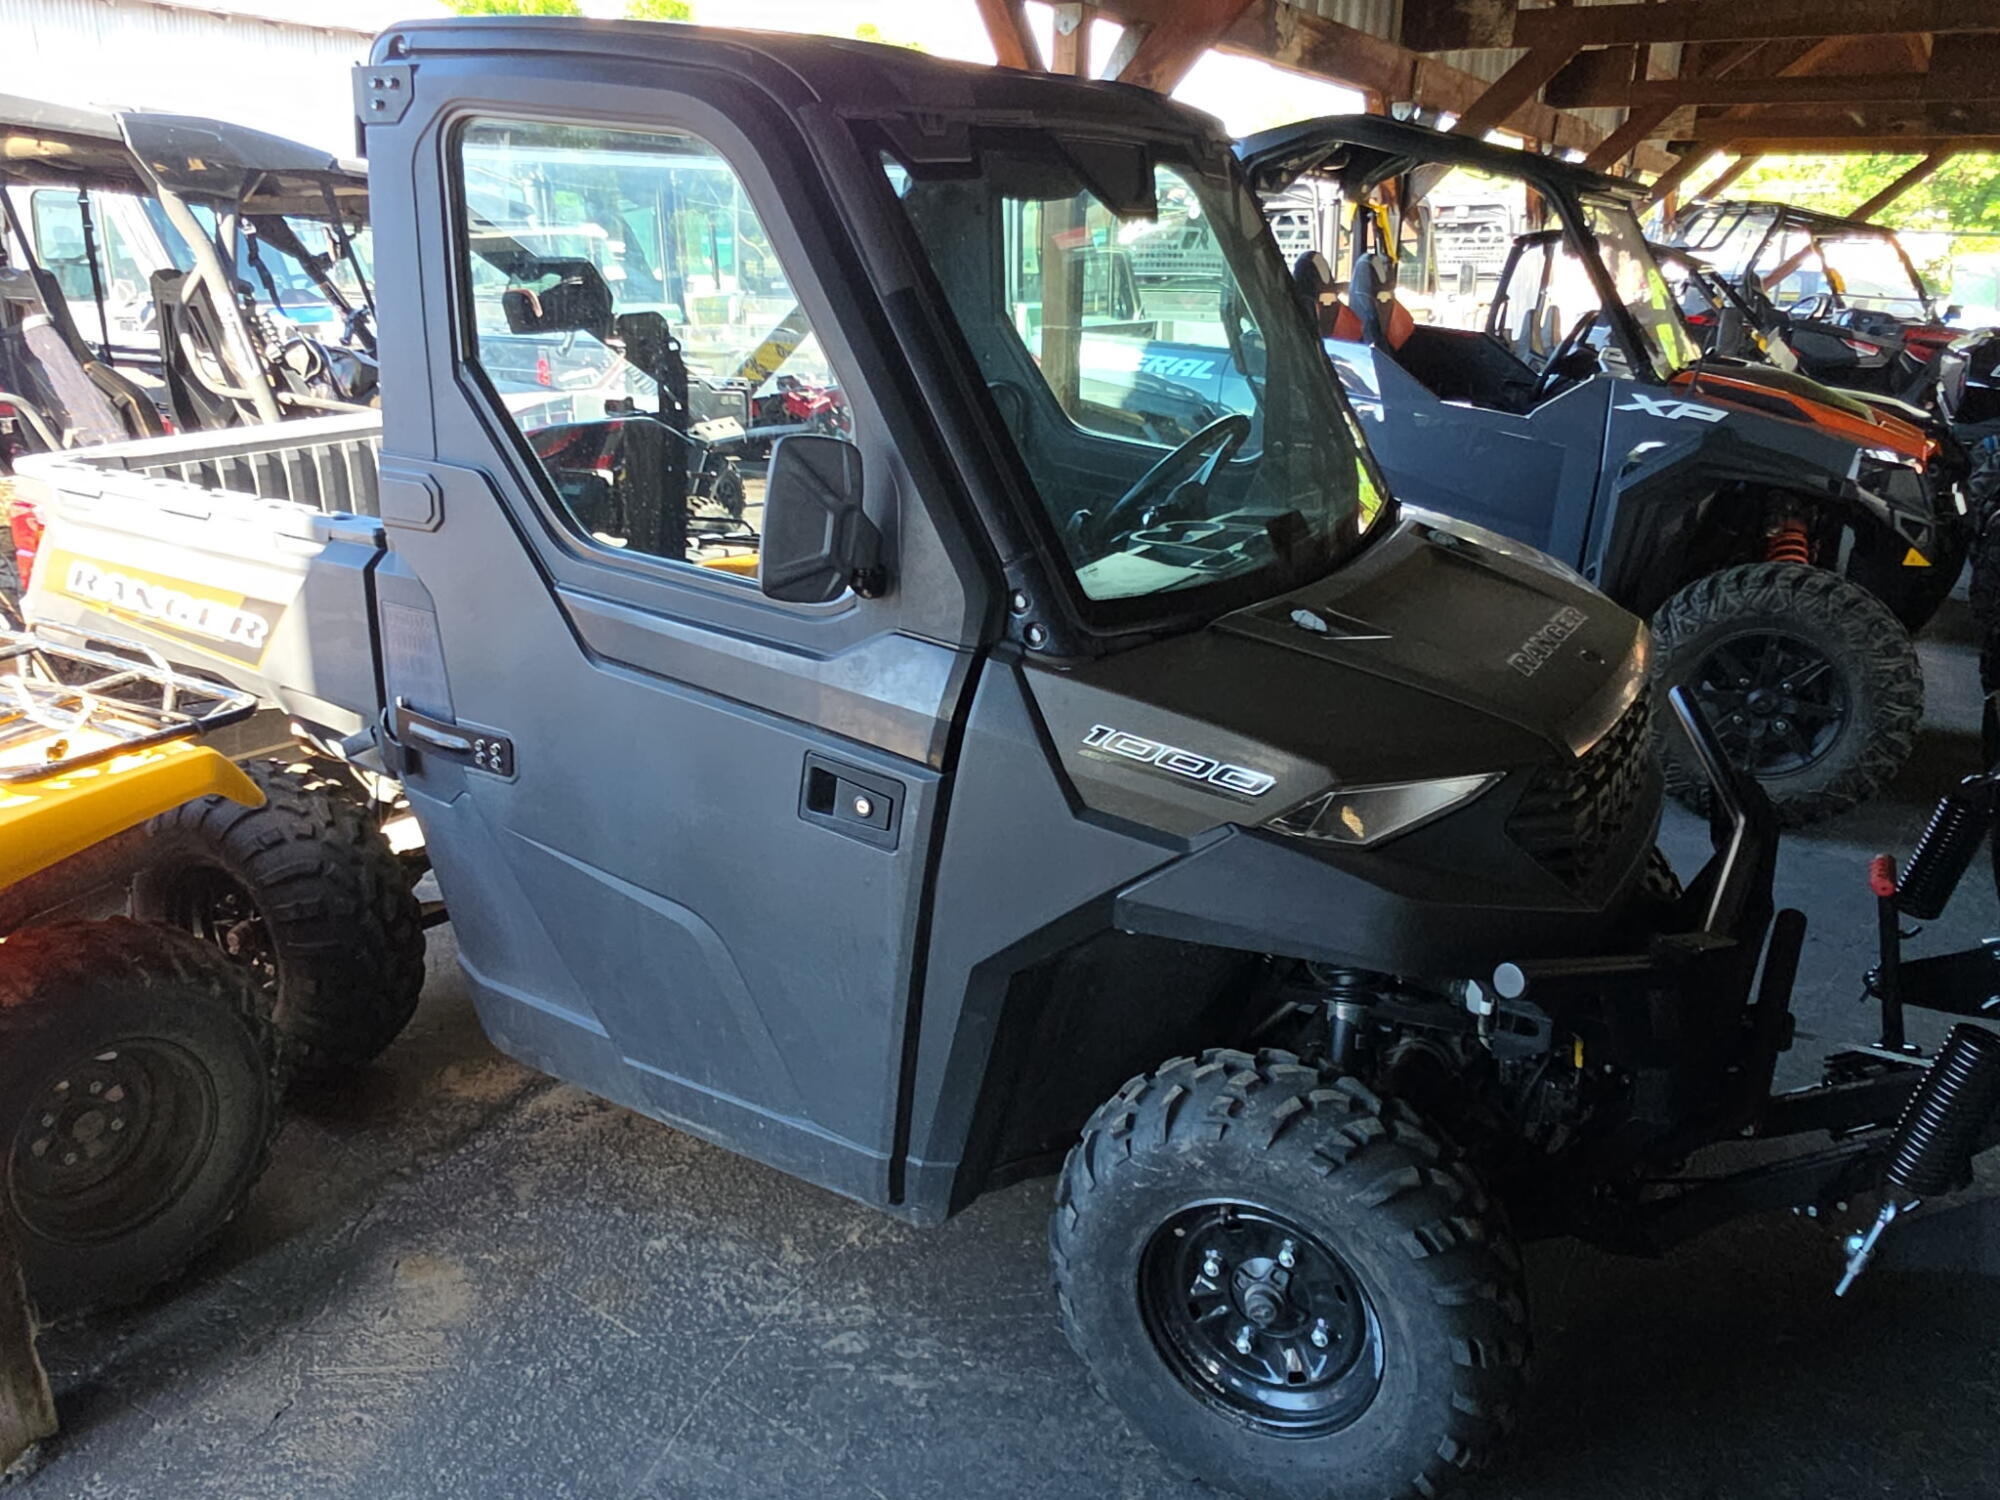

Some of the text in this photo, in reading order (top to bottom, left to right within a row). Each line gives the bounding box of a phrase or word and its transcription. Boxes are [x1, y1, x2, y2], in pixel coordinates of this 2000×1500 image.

[1613, 393, 1730, 423] XP
[1506, 606, 1590, 678] RANGER
[1083, 724, 1277, 796] 1000
